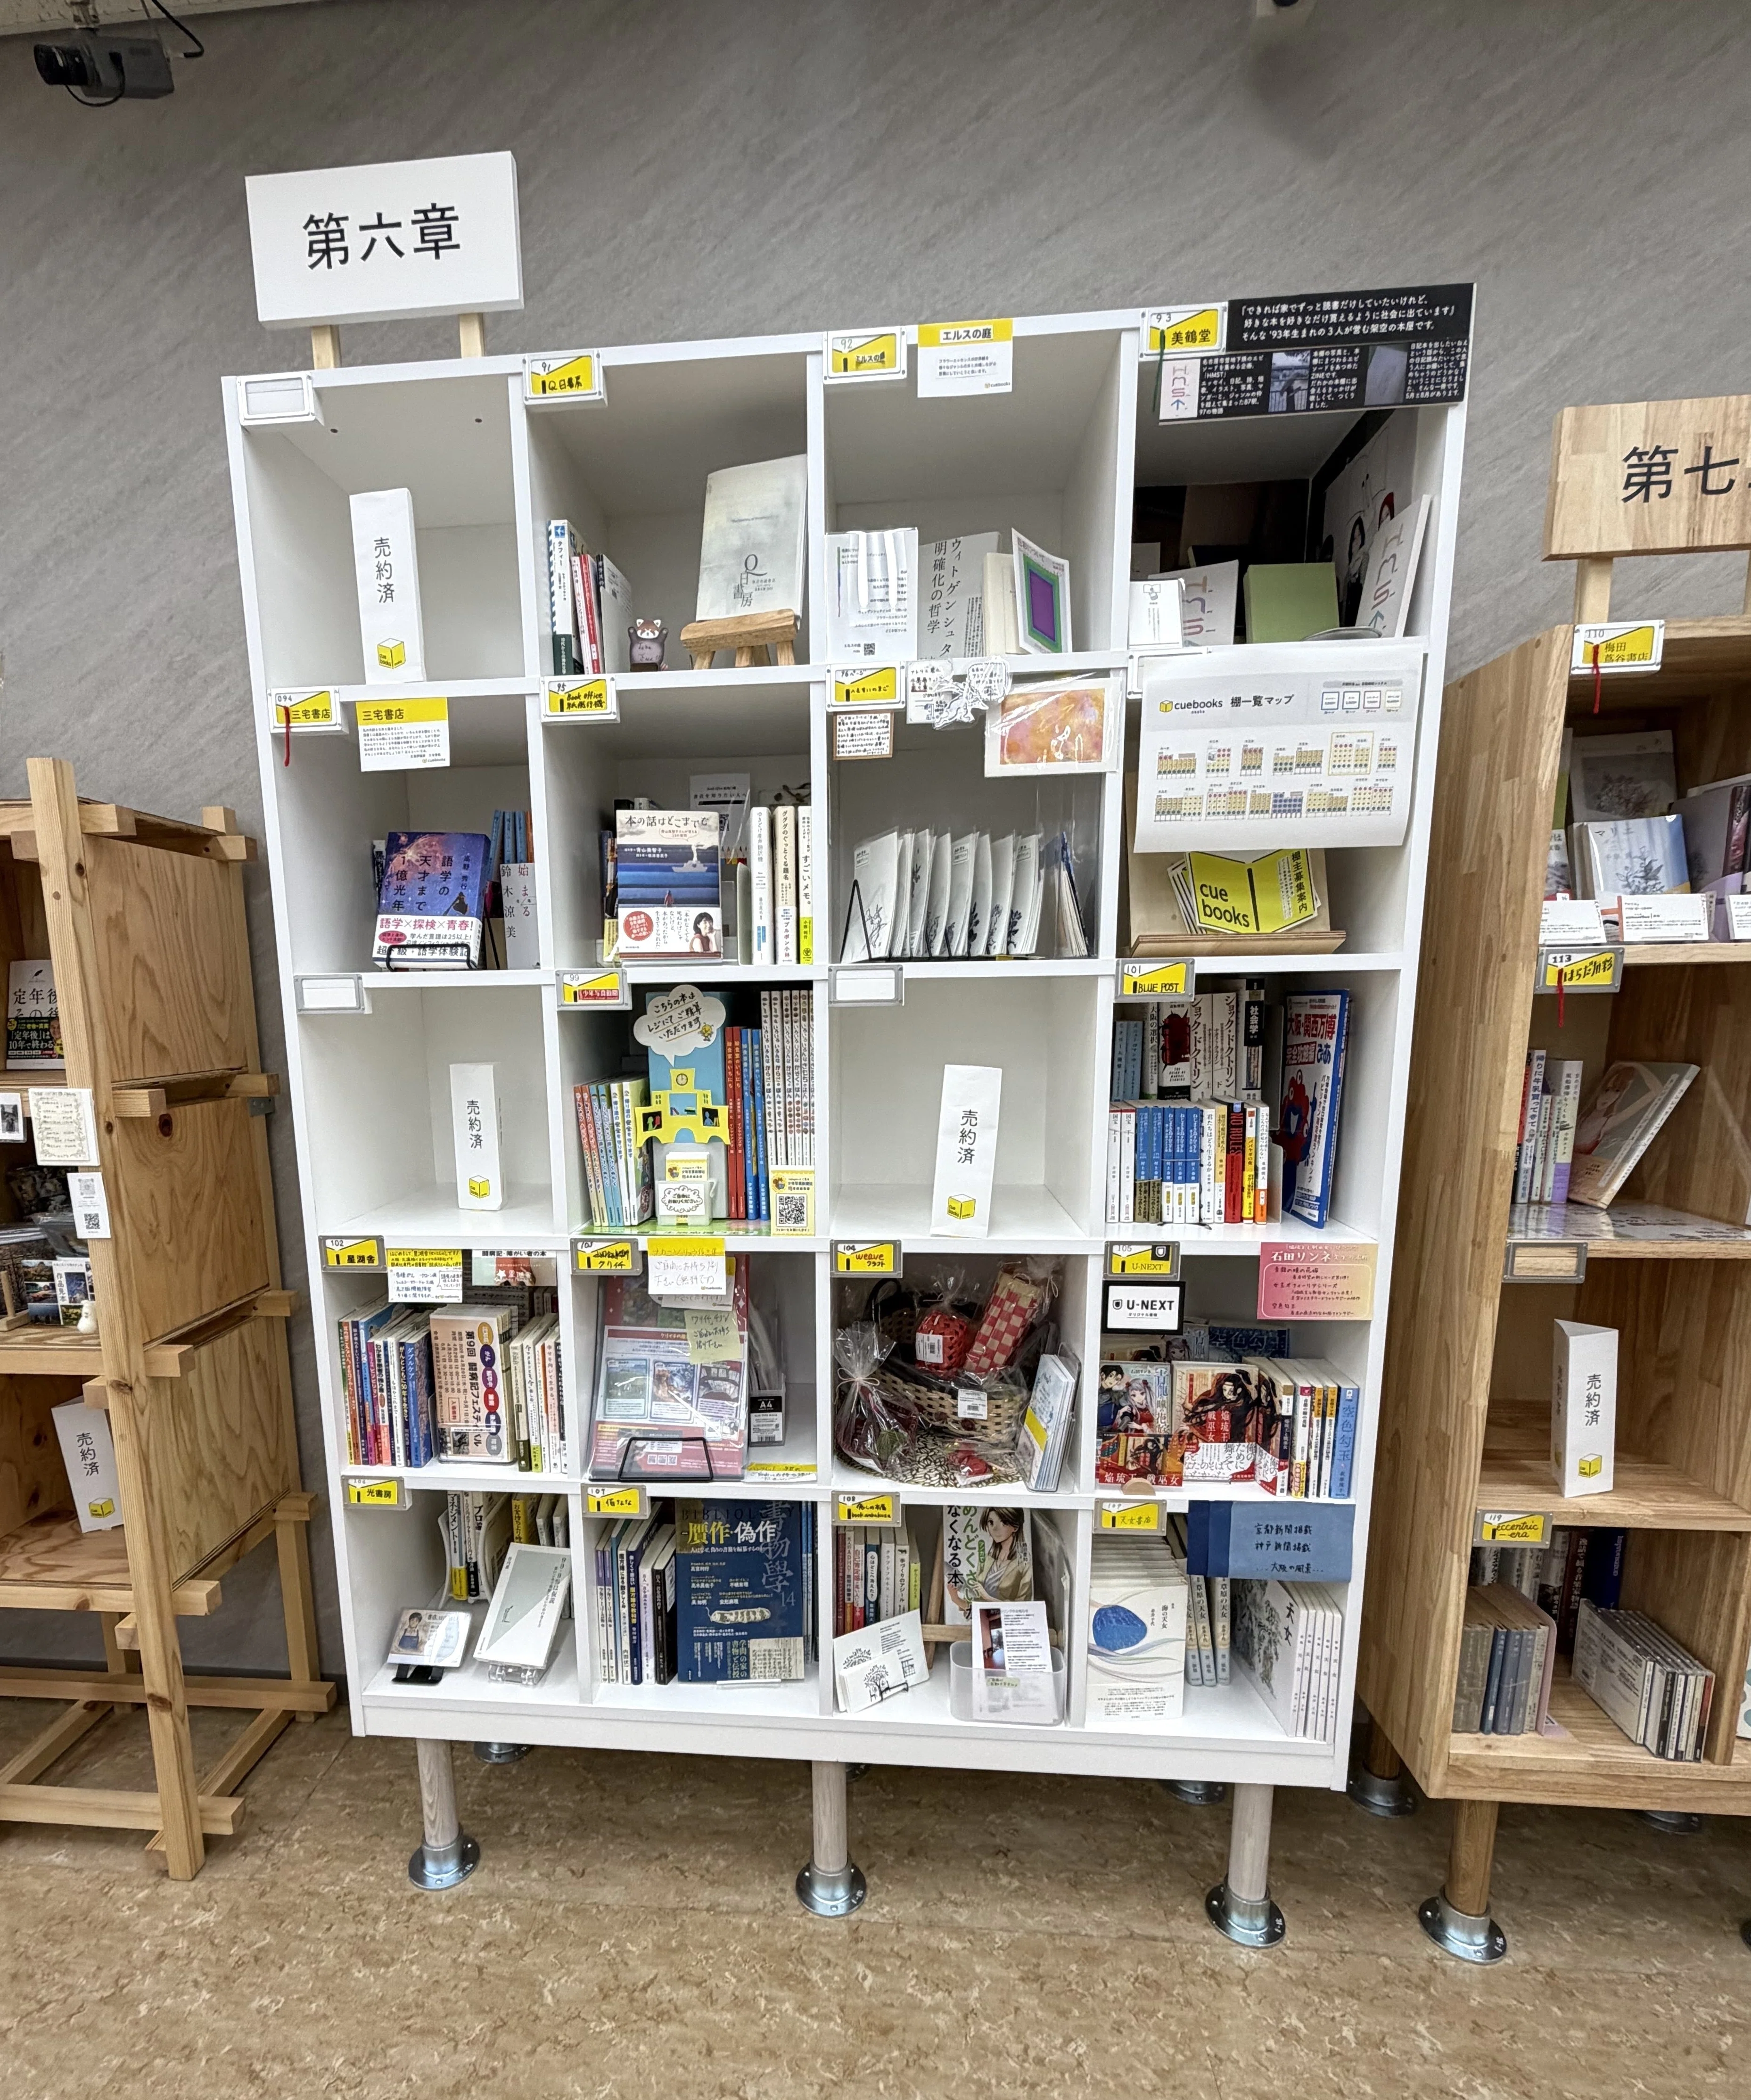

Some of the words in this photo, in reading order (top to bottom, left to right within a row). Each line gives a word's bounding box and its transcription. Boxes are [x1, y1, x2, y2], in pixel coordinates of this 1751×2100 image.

[303, 203, 460, 270] 第六章
[1156, 313, 1171, 322] 93
[943, 328, 992, 341] エルスの庭
[1172, 329, 1211, 345] 美鶴堂
[840, 339, 853, 349] 92
[1622, 445, 1751, 503] 第七
[374, 537, 395, 603] 売約済
[927, 541, 947, 634] 明確化の哲学
[1587, 629, 1604, 638] 110
[1605, 642, 1626, 652] 梅田
[557, 683, 566, 692] 95
[1174, 699, 1223, 710] cuebooks
[1230, 694, 1294, 707] 棚一覧マップ
[291, 708, 331, 720] 三宅書店
[362, 708, 404, 721] 三宅書店
[625, 815, 709, 828] 本の話はどこまでも
[1595, 827, 1634, 837] マリエ
[392, 856, 408, 911] 1億光年
[416, 856, 432, 911] 天才まで
[439, 856, 453, 896] 語学の
[802, 855, 811, 905] すごいメモ。
[1291, 850, 1308, 914] 棚主募集案内
[1200, 883, 1228, 902] cue
[501, 865, 516, 938] 鈴木涼美
[1201, 899, 1250, 928] books
[1552, 955, 1572, 964] 113
[1127, 965, 1141, 974] 101
[1138, 983, 1158, 993] BLUE
[1160, 983, 1180, 992] POST
[653, 992, 696, 1013] こちらの本は
[1249, 1005, 1259, 1034] 社会学
[1287, 1013, 1336, 1040] 大阪・関西万博
[11, 1030, 50, 1040] 「定年後」は
[659, 1017, 701, 1040] いただけます
[9, 1040, 54, 1049] 10年で終わる
[1192, 997, 1203, 1089] ショック・ドクトリン
[1225, 995, 1236, 1087] ショック・ドクトリン
[1317, 1042, 1331, 1066] ぴあ
[467, 1099, 483, 1149] 売約済
[1230, 1113, 1243, 1125] NO
[957, 1109, 978, 1164] 売約済
[1230, 1128, 1243, 1155] RULES
[330, 1239, 344, 1247] 102
[855, 1252, 884, 1260] weave
[1271, 1251, 1331, 1262] 石田リンネ
[598, 1260, 626, 1269] クリイチ
[1132, 1263, 1163, 1271] U-NEXT
[1126, 1300, 1175, 1311] U-NEXT
[465, 1331, 477, 1357] 第9回
[759, 1400, 773, 1408] A4
[1584, 1373, 1602, 1428] 売約済
[1338, 1405, 1354, 1461] 空色勾玉
[76, 1431, 99, 1476] 売約済
[367, 1488, 392, 1499] 光書房
[688, 1520, 777, 1545] 贋作・偽作
[1254, 1523, 1313, 1536] 京都新聞掲載
[1496, 1521, 1539, 1531] eccentric
[946, 1505, 963, 1587] なくなる本
[1255, 1540, 1312, 1553] 神戸新聞掲載
[781, 1591, 796, 1607] 14
[1196, 1584, 1207, 1619] 草原の天女
